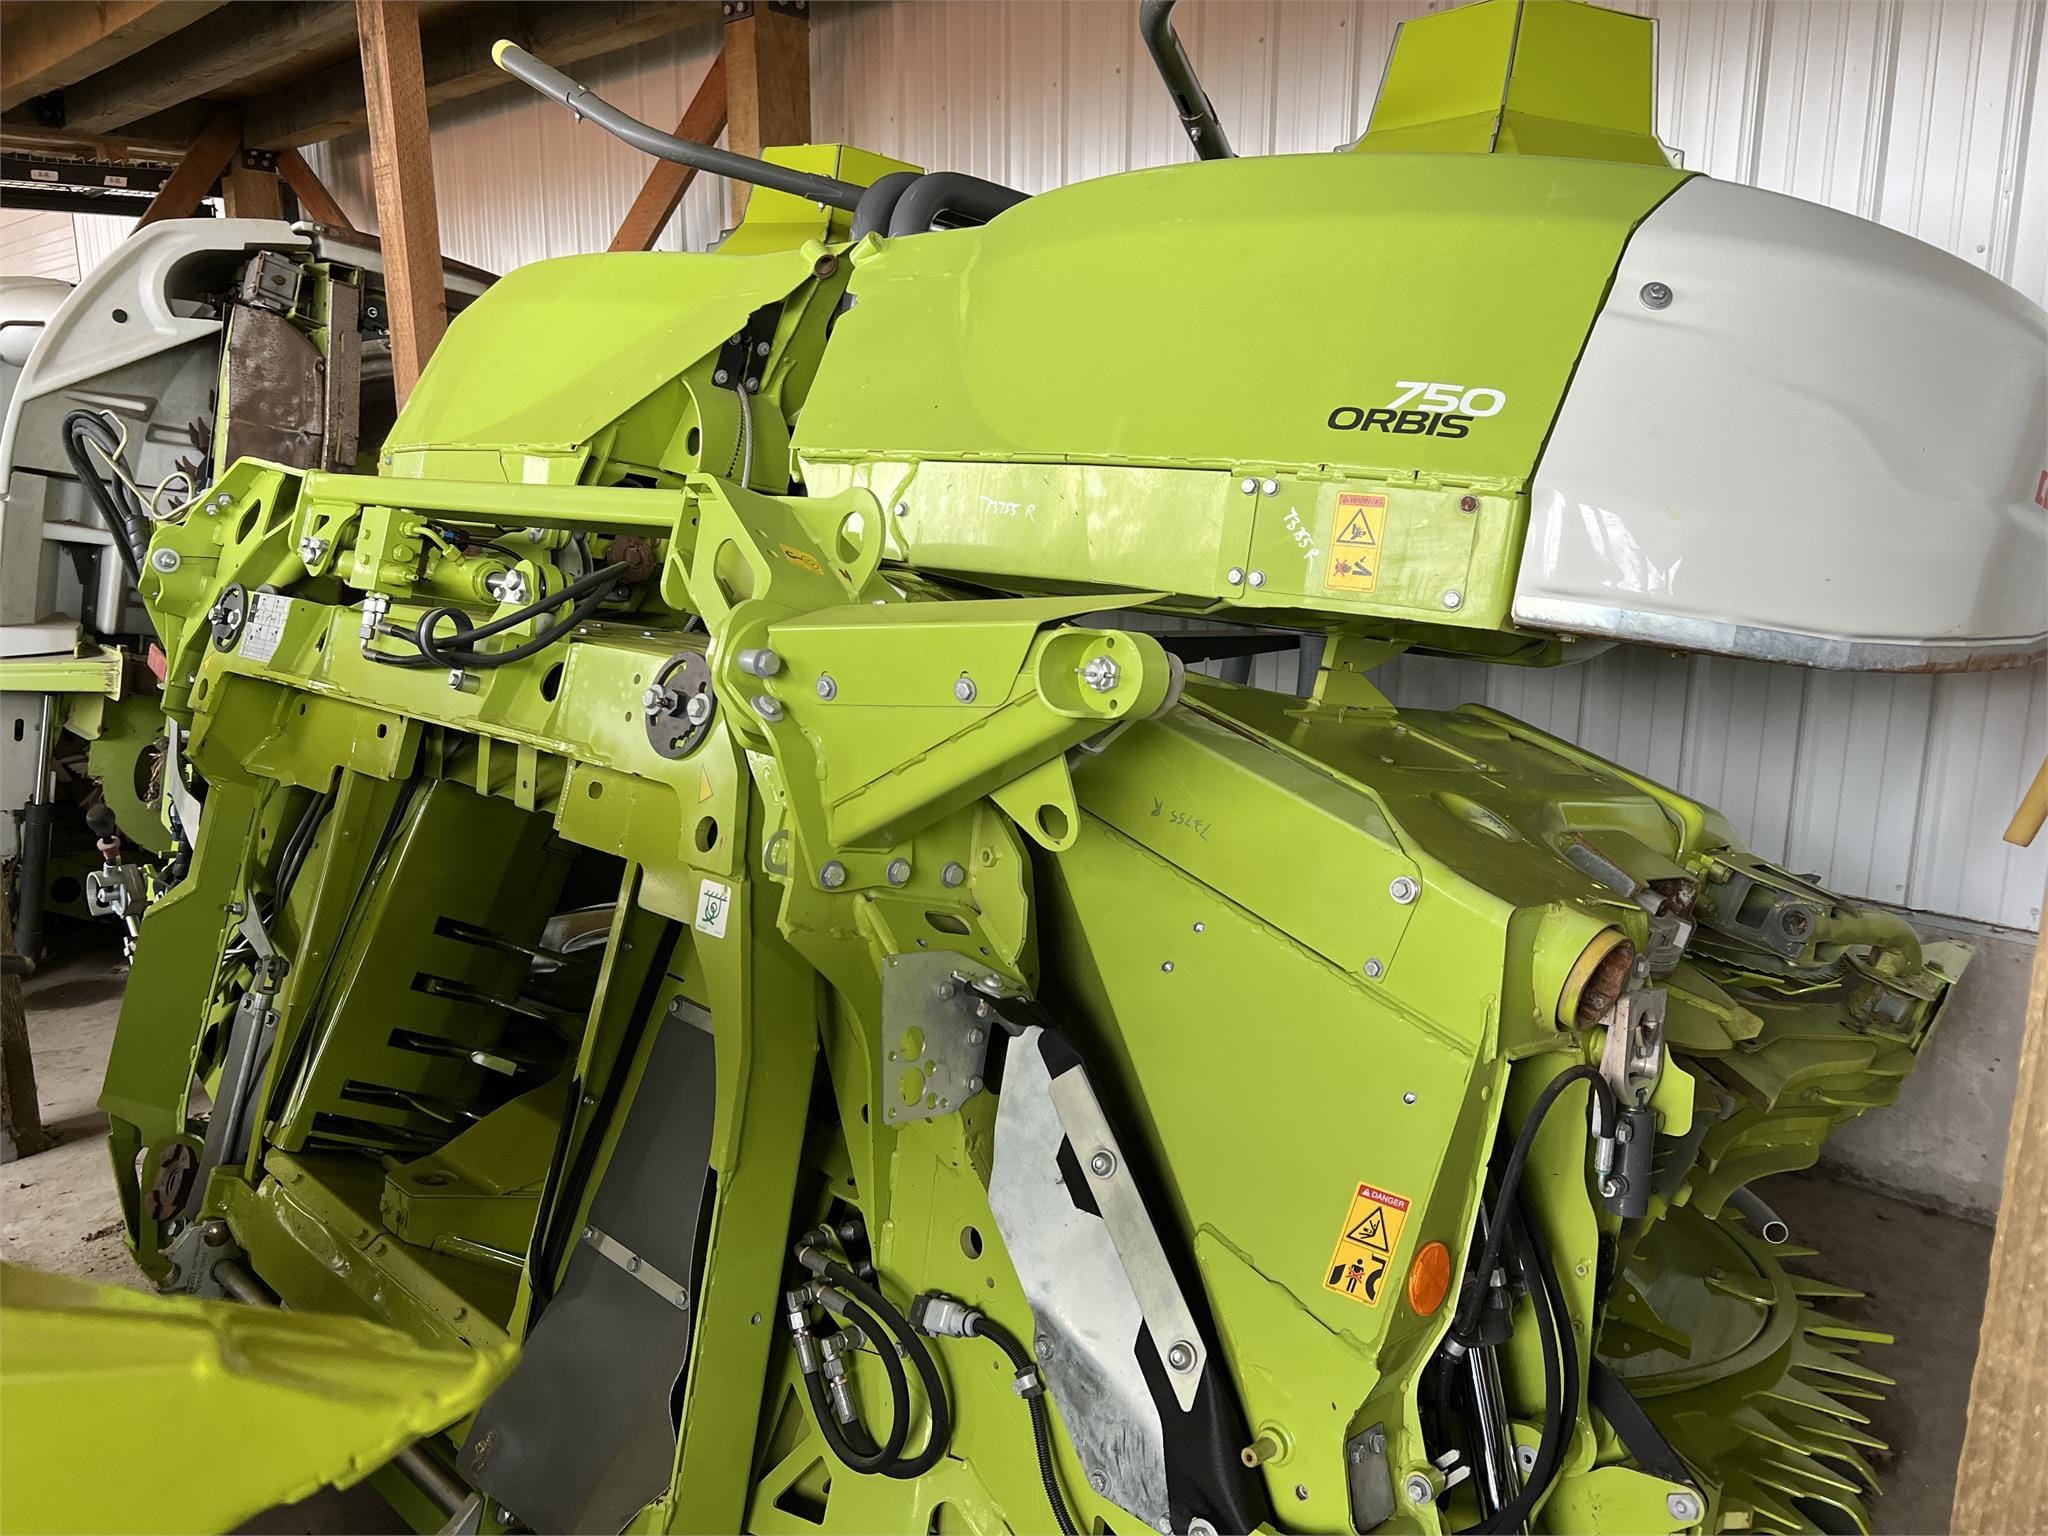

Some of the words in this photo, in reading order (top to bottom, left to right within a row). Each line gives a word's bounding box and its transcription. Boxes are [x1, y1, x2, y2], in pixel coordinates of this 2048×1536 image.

[1385, 380, 1507, 417] 750
[1327, 406, 1474, 439] ORBIS
[1024, 503, 1037, 522] R
[1303, 547, 1320, 573] R
[1150, 797, 1163, 816] R
[1370, 1190, 1405, 1209] DANGER
